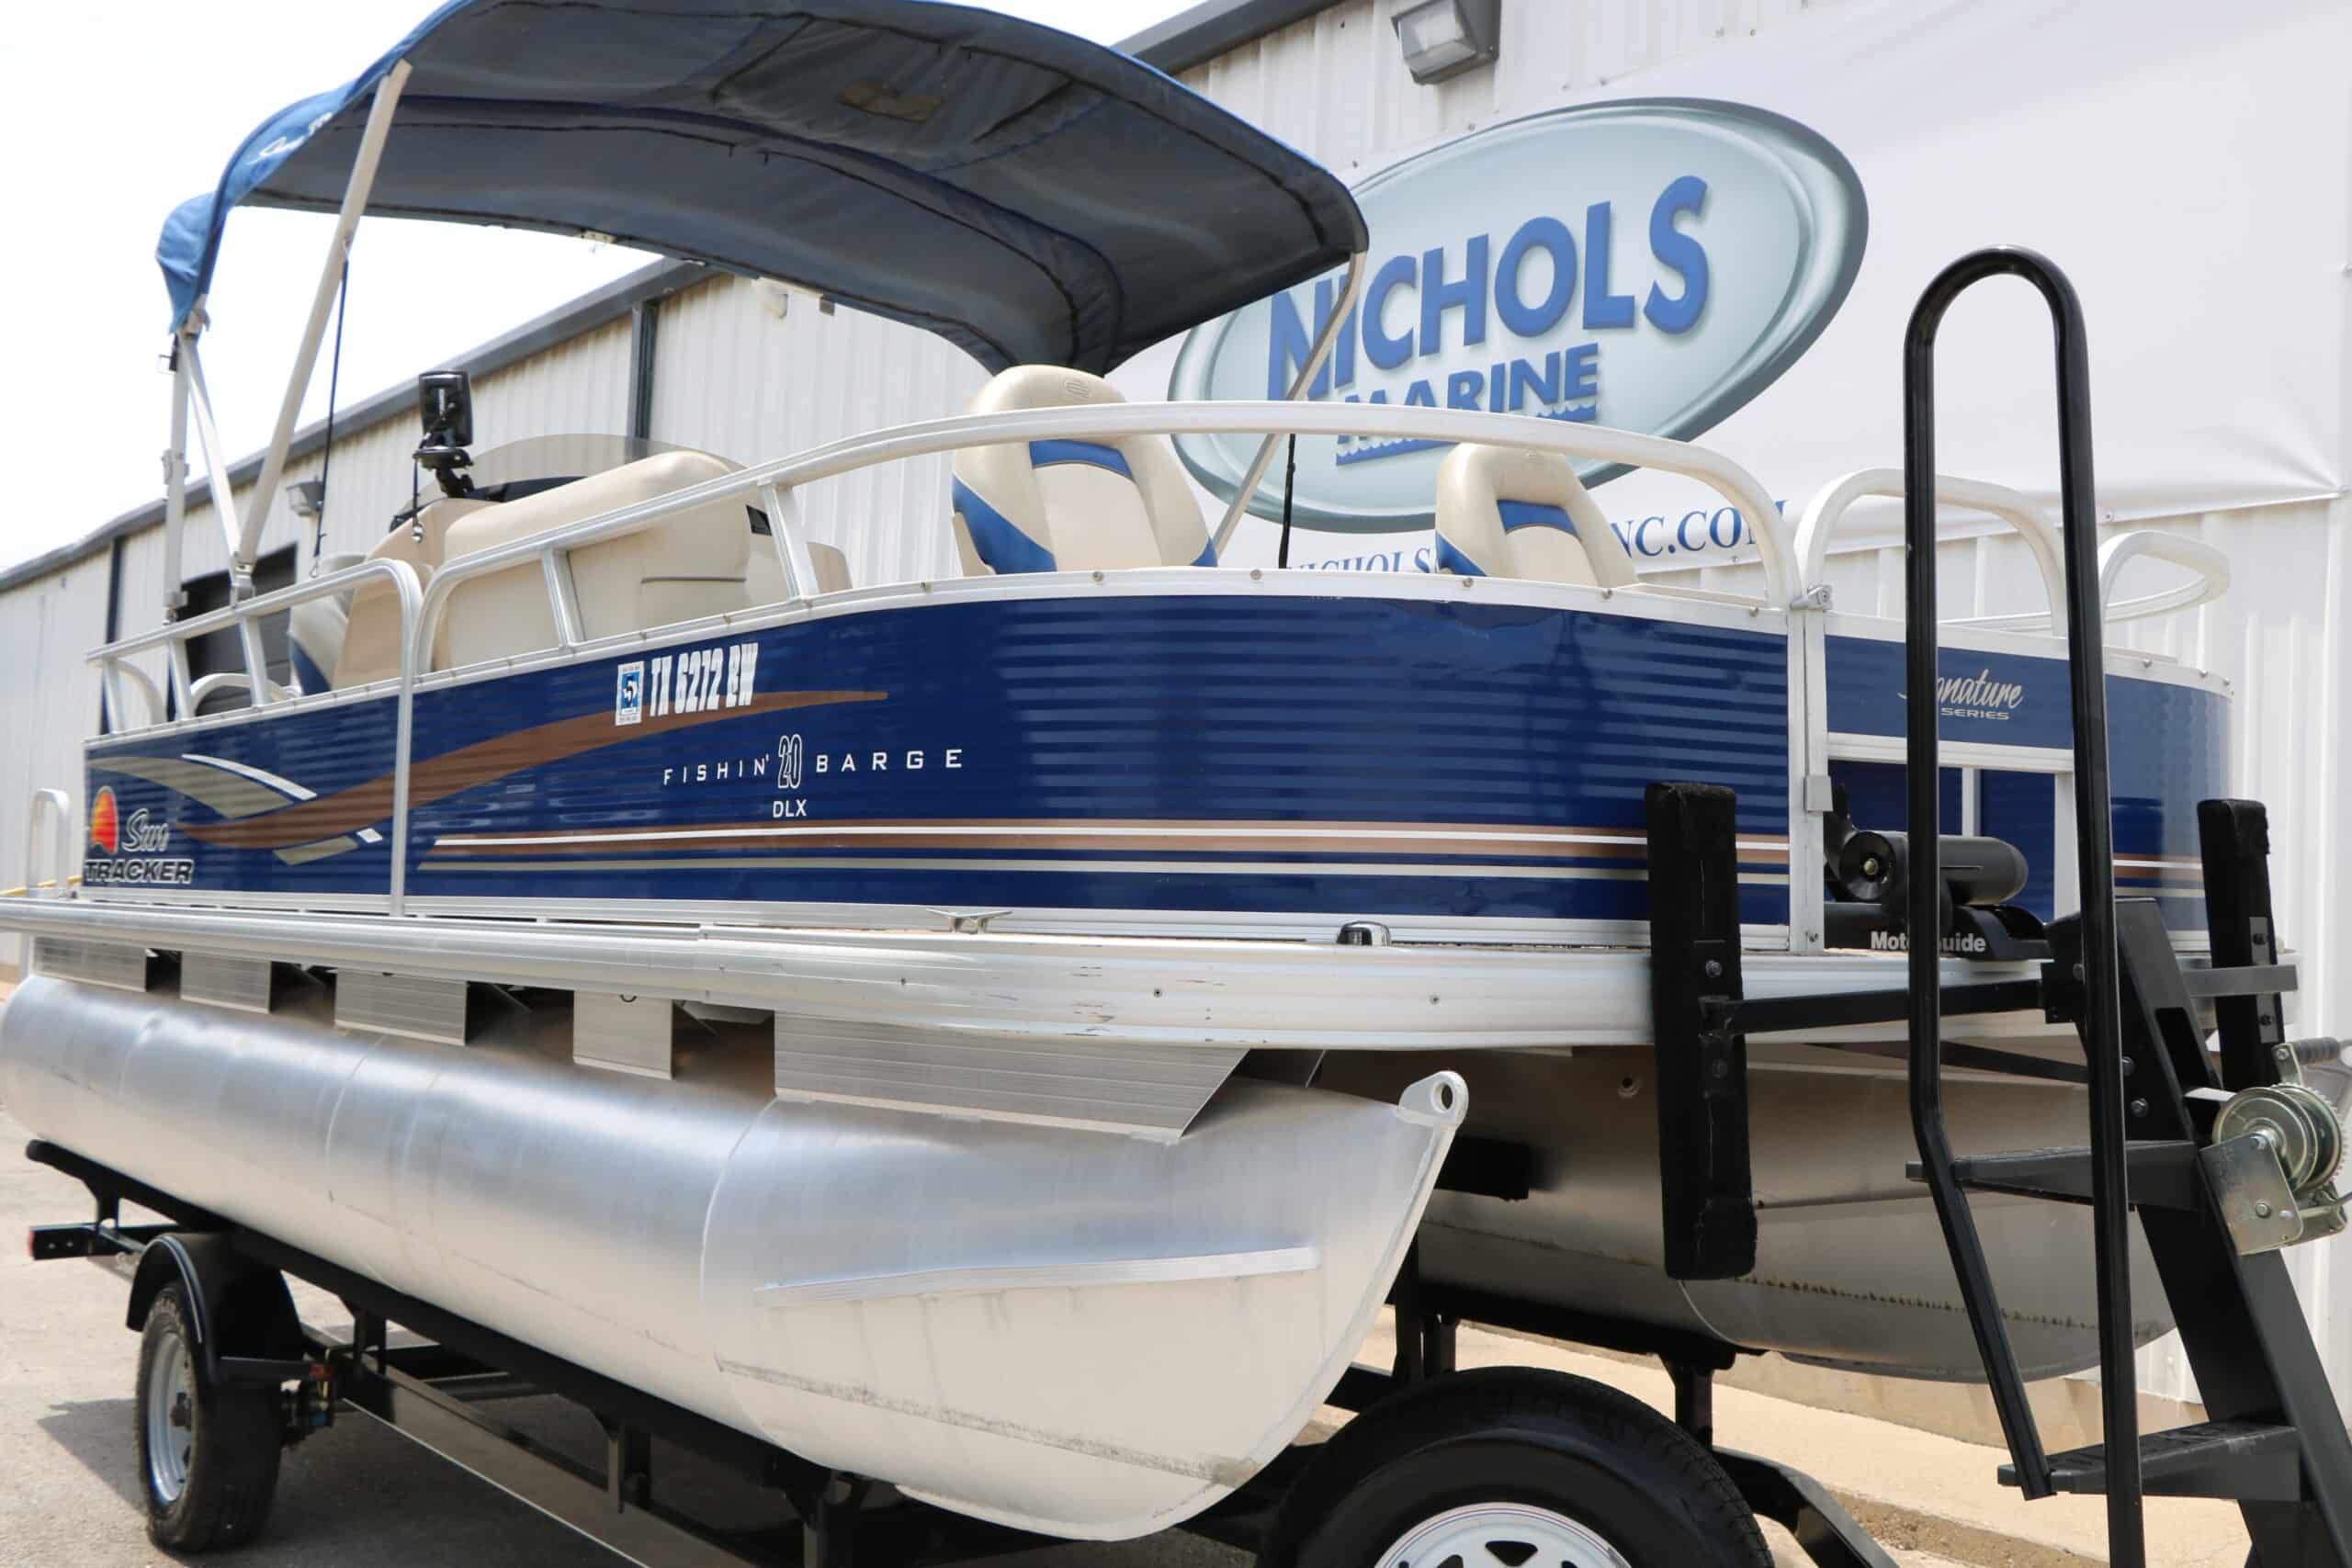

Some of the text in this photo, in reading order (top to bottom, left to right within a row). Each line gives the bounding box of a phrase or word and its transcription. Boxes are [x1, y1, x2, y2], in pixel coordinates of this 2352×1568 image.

[1267, 175, 1708, 401] NICHOLS
[1338, 342, 1599, 445] ARINE
[1610, 499, 1789, 558] NC.CO
[650, 656, 673, 716] TX
[674, 648, 724, 714] 6272
[1940, 707, 2010, 720] SERIES
[663, 734, 963, 789] FISHIN' 20 BARGE
[121, 808, 169, 852] Sun
[773, 799, 808, 818] DLX
[84, 859, 195, 884] TRACKER
[1871, 931, 1986, 953] Motuide
